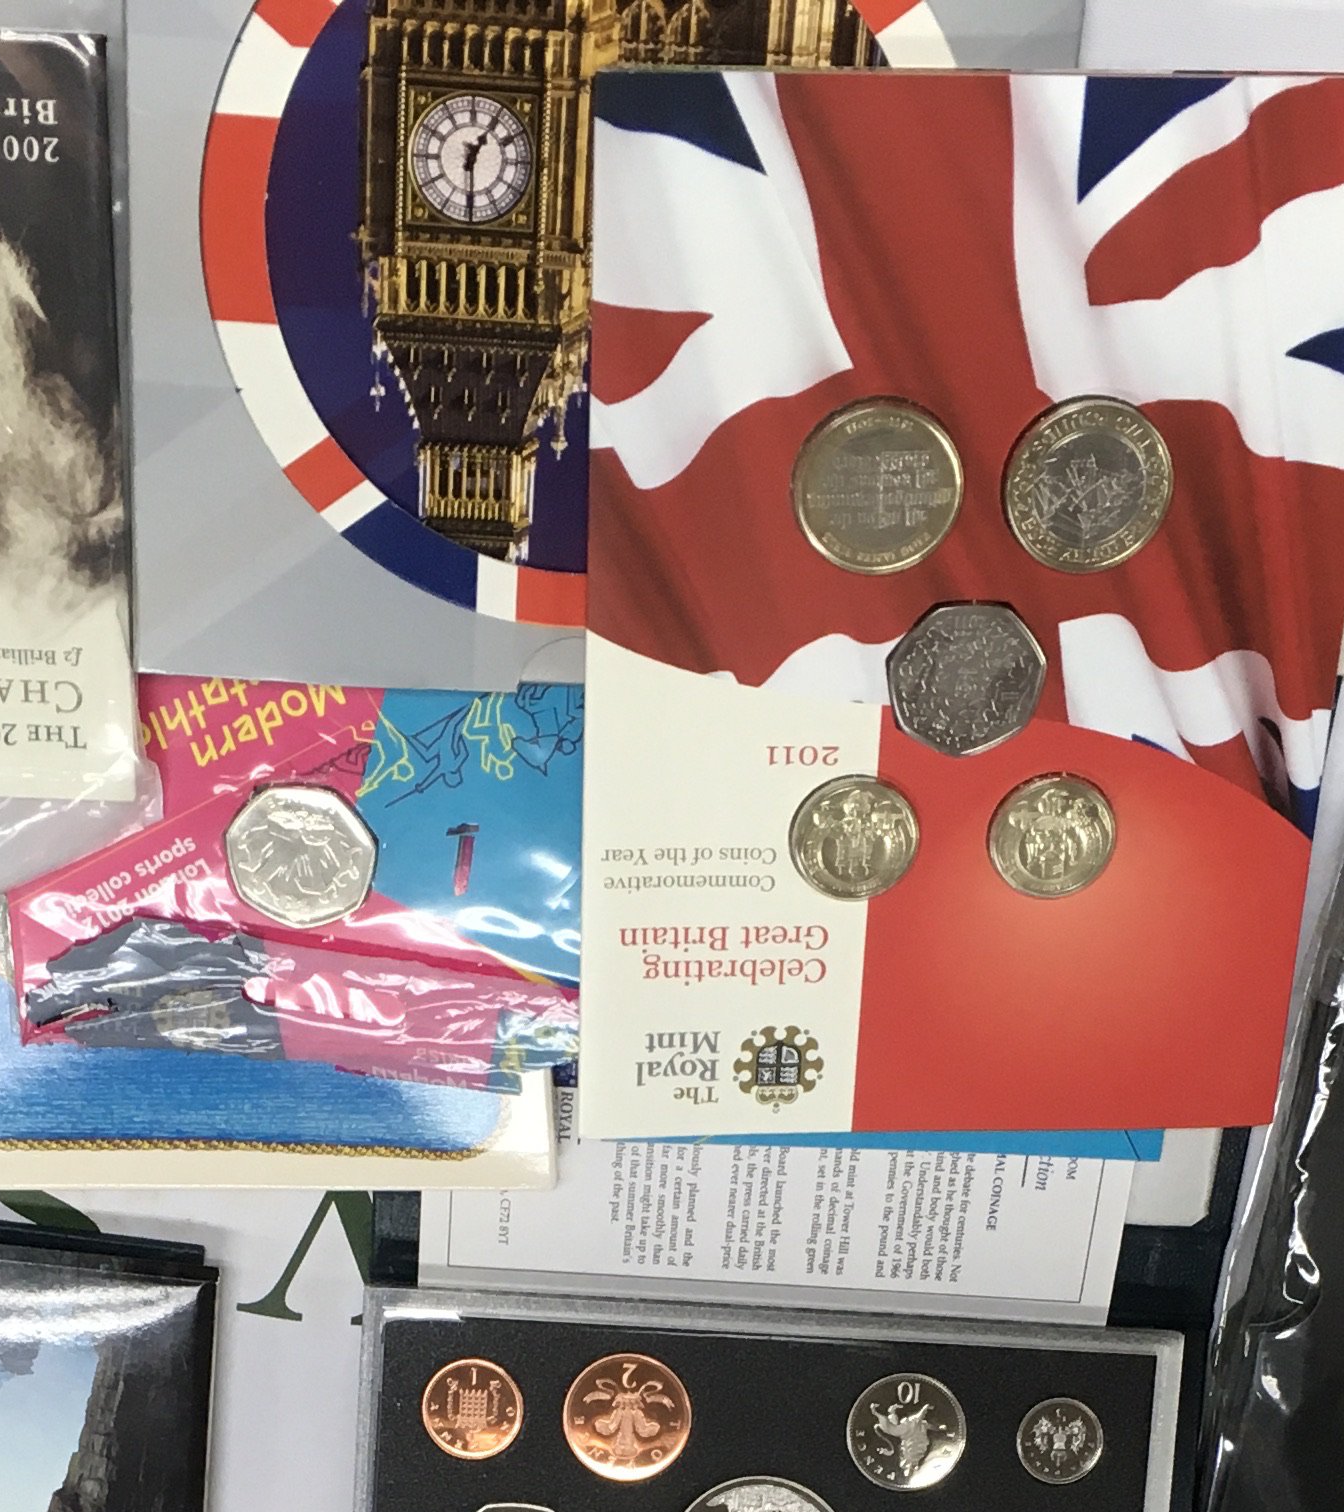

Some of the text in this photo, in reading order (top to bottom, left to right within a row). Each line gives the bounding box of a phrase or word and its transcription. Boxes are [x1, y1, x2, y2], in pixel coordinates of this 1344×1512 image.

[63, 646, 83, 667] £2
[26, 724, 87, 750] THE
[190, 684, 346, 767] Modern
[765, 745, 840, 766] 2011
[134, 836, 196, 873] sports
[600, 846, 777, 866] Coins of the Year
[603, 873, 776, 894] Commemorative
[618, 924, 829, 953] Great Britain
[642, 953, 827, 986] Celebrating
[644, 1030, 722, 1054] Mint
[634, 1052, 720, 1086] Royal
[673, 1085, 719, 1105] The
[557, 1091, 574, 1145] ROYAL
[499, 1198, 510, 1223] CF72
[986, 1177, 1003, 1231] COINAGE
[903, 1161, 931, 1280] Understandably perhaps
[949, 1165, 975, 1283] debate for centuries. Not
[621, 1361, 639, 1389] 2
[897, 1380, 920, 1405] 10
